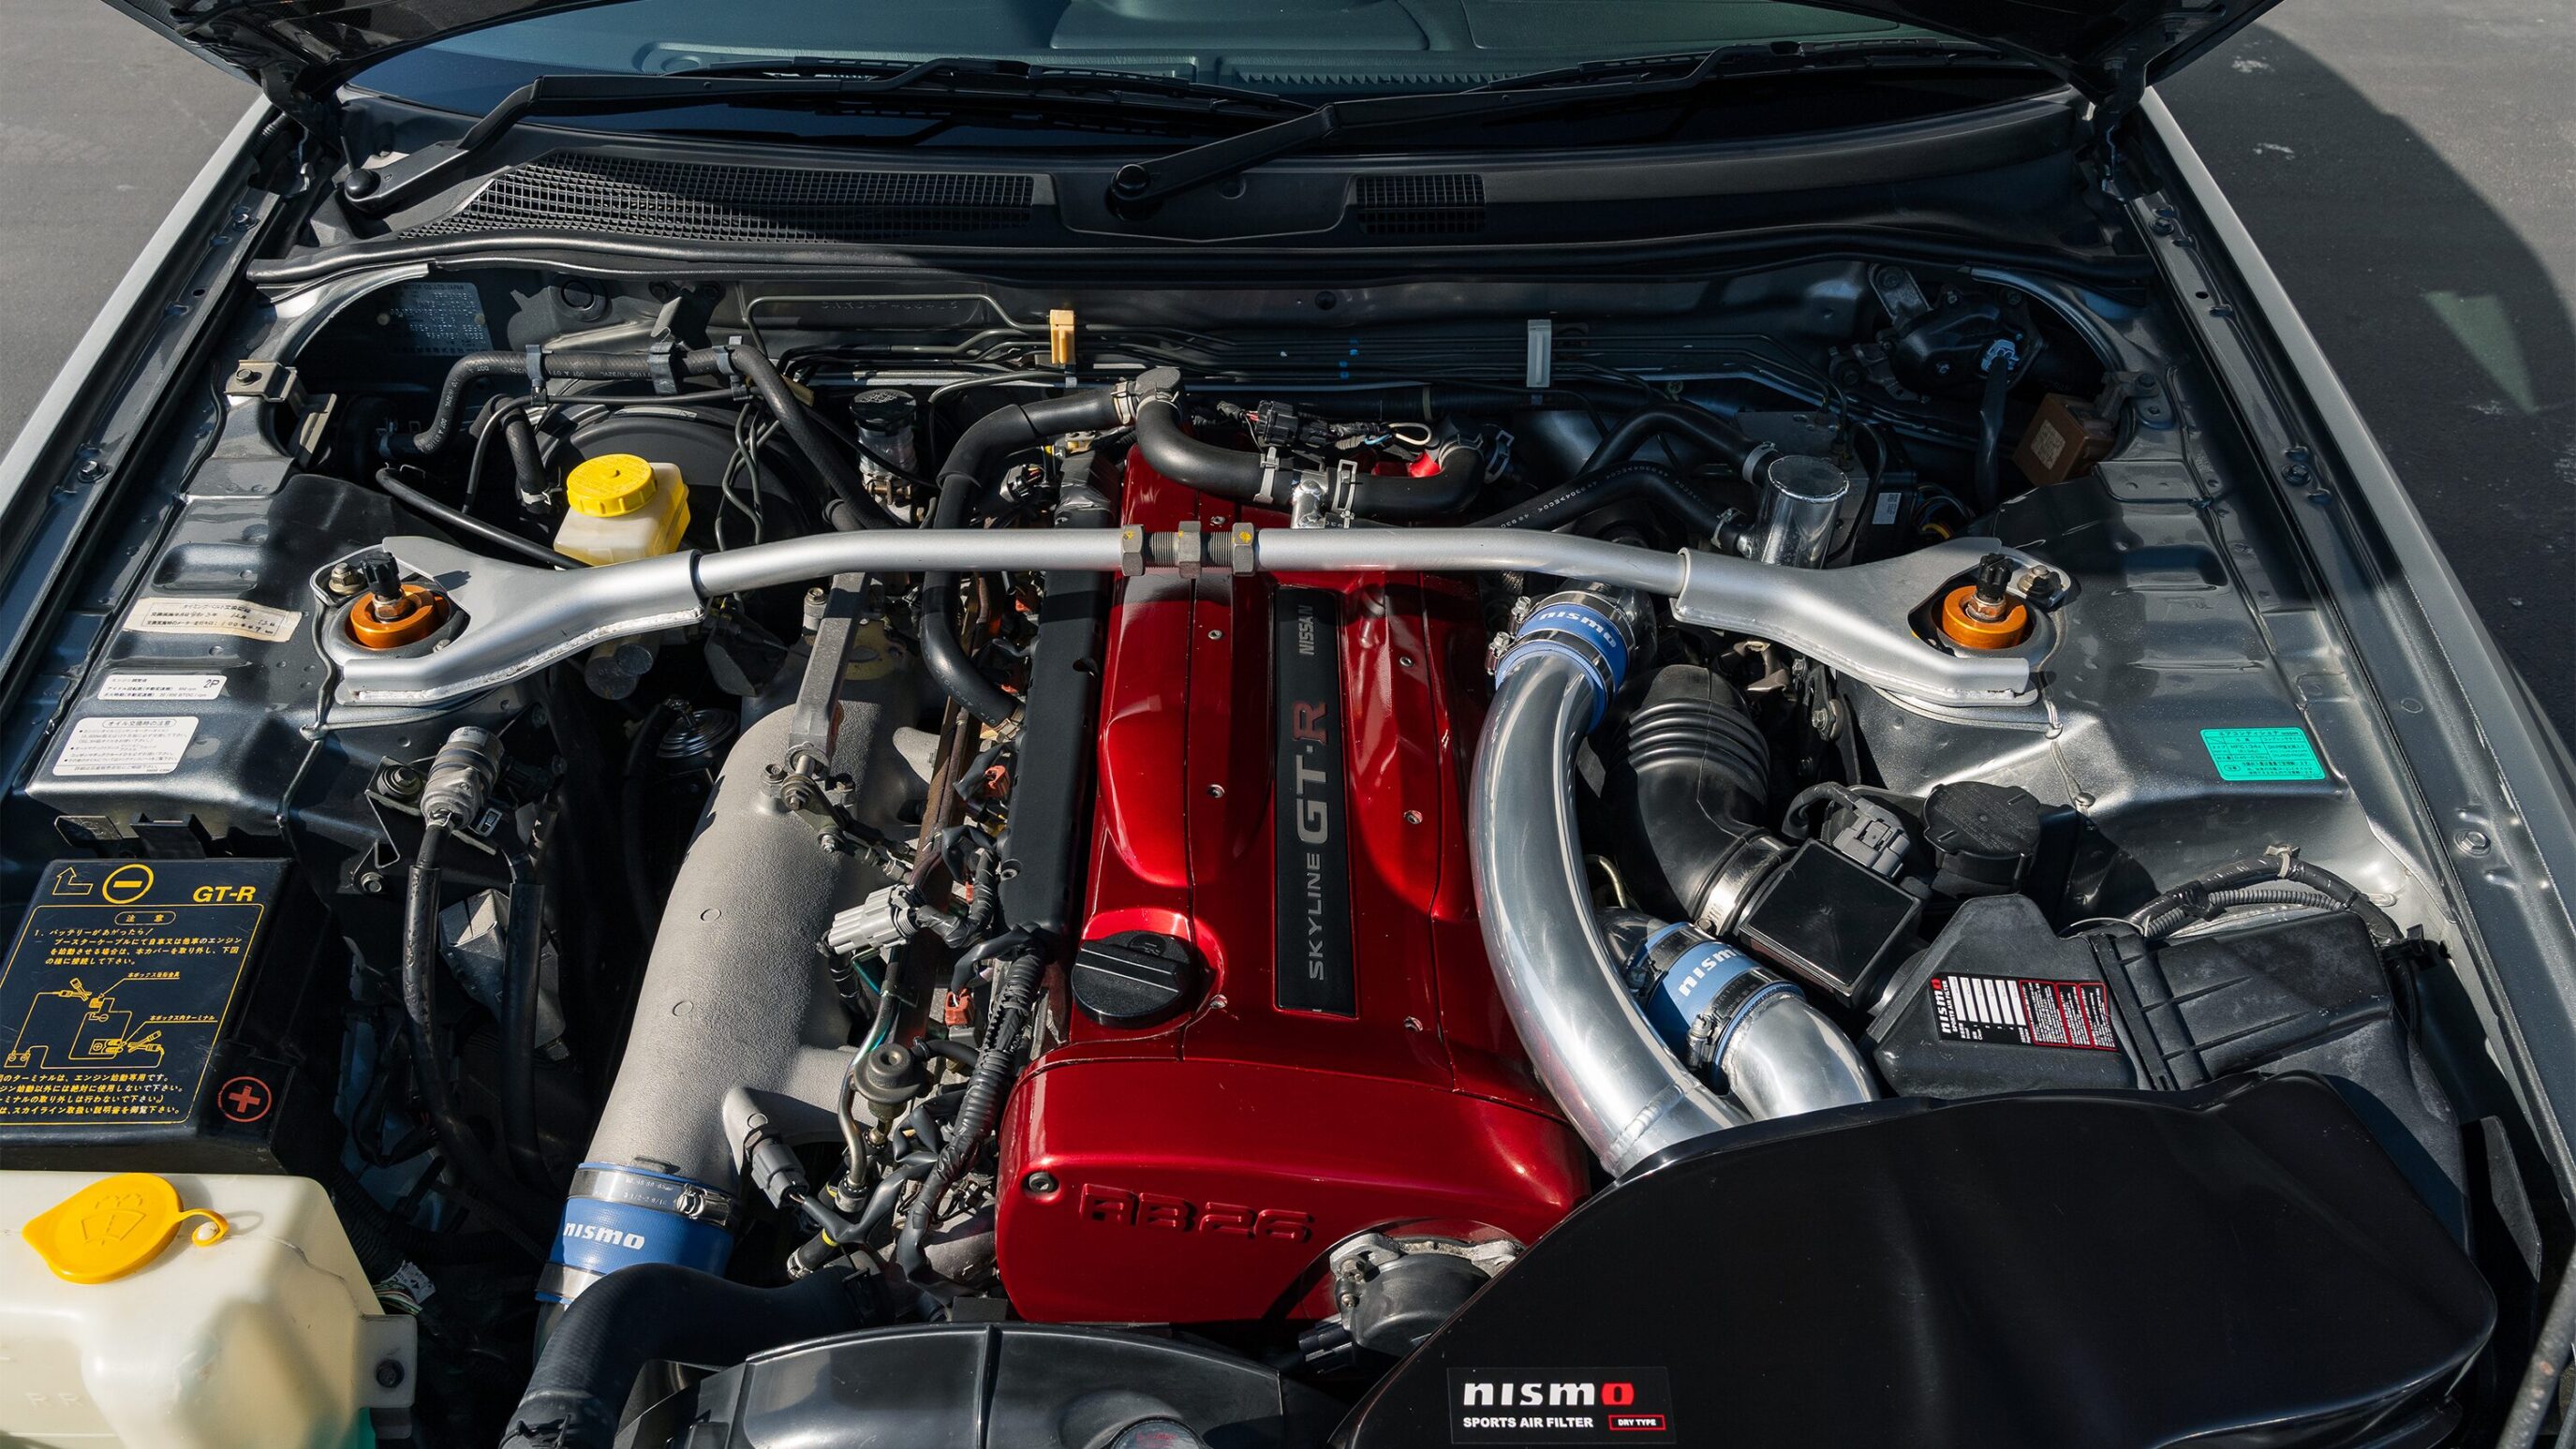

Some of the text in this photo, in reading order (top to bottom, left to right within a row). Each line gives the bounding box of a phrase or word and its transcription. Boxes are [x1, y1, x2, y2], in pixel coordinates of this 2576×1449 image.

[1298, 604, 1314, 656] NISSAN
[1539, 611, 1617, 648] nismo
[203, 679, 220, 688] 2P
[193, 886, 257, 902] GT-R
[1307, 852, 1324, 981] SKYLINE
[1942, 980, 1951, 999] FILTER
[1931, 978, 1952, 1034] nismo
[1948, 1011, 1959, 1032] SPORTS
[1080, 1183, 1312, 1243] RB26
[563, 1222, 645, 1250] nismo
[1463, 1382, 1635, 1406] nismo
[1463, 1416, 1657, 1428] SPORTS AIR FILTER DRY TYPE
